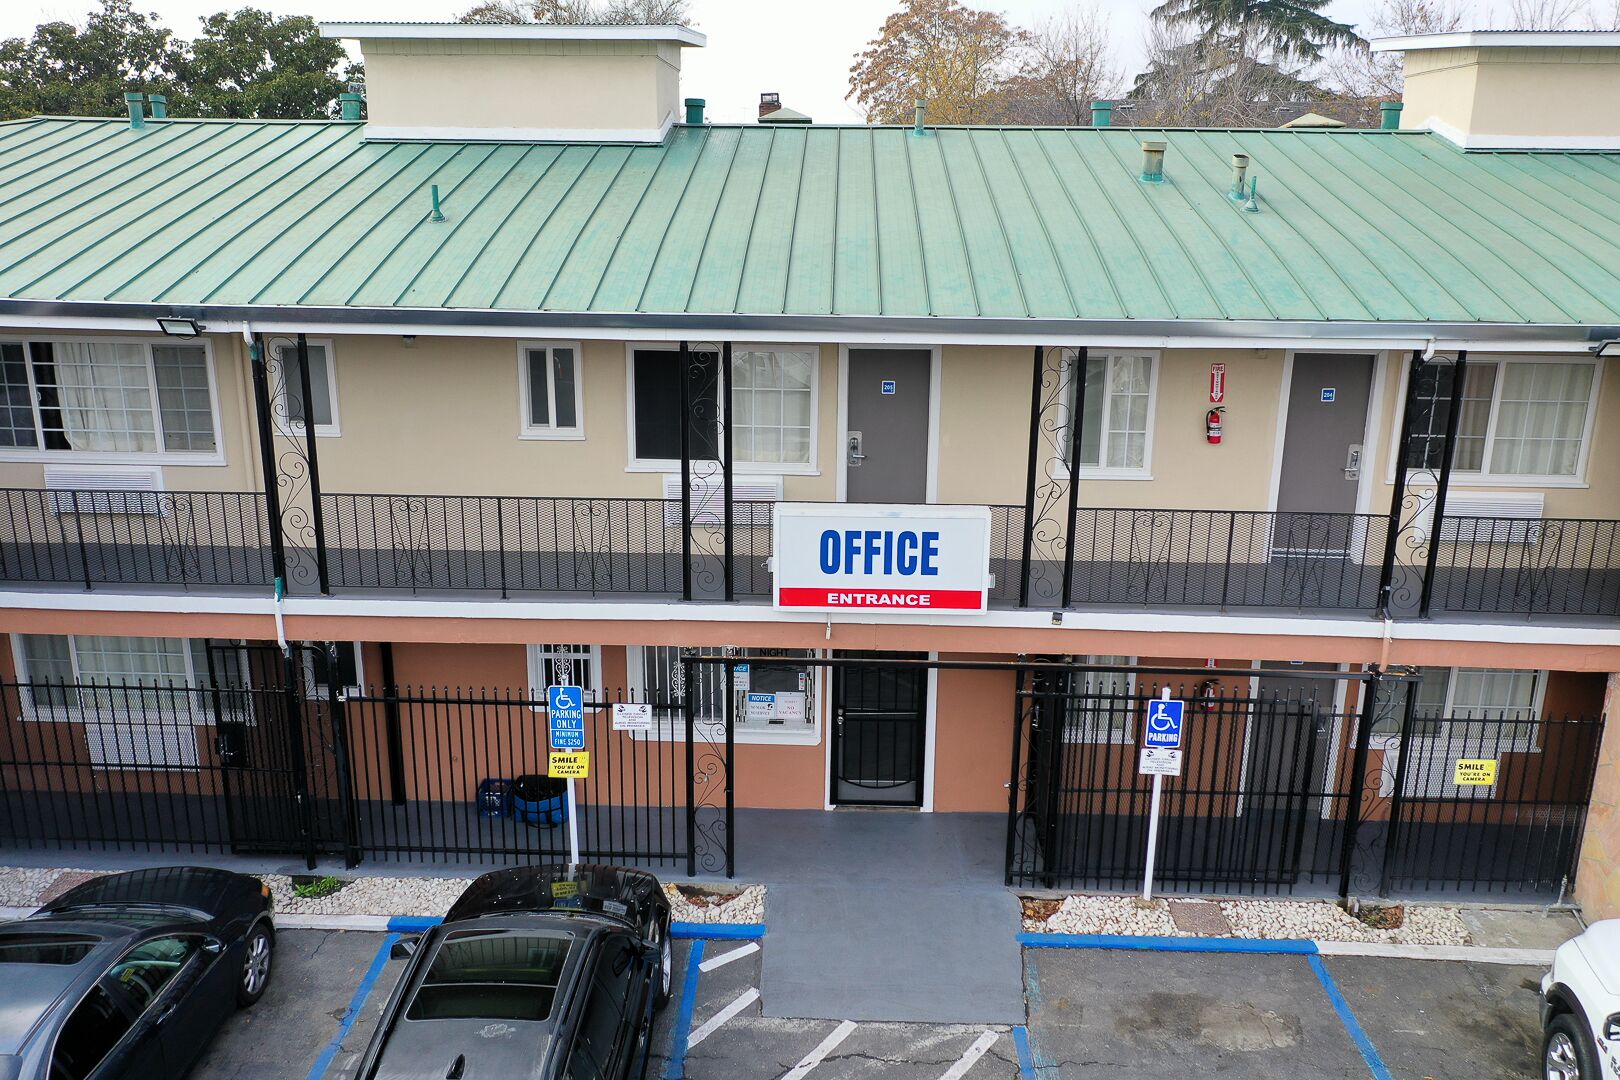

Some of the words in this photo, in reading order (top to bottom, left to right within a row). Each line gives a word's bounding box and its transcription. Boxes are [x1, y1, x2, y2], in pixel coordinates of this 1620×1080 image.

[820, 530, 940, 576] OFFICE
[827, 593, 931, 606] ENTRANCE
[760, 648, 790, 656] NIGHT
[552, 710, 581, 718] PARKING
[556, 720, 576, 728] ONLY
[1148, 733, 1178, 742] PARKING
